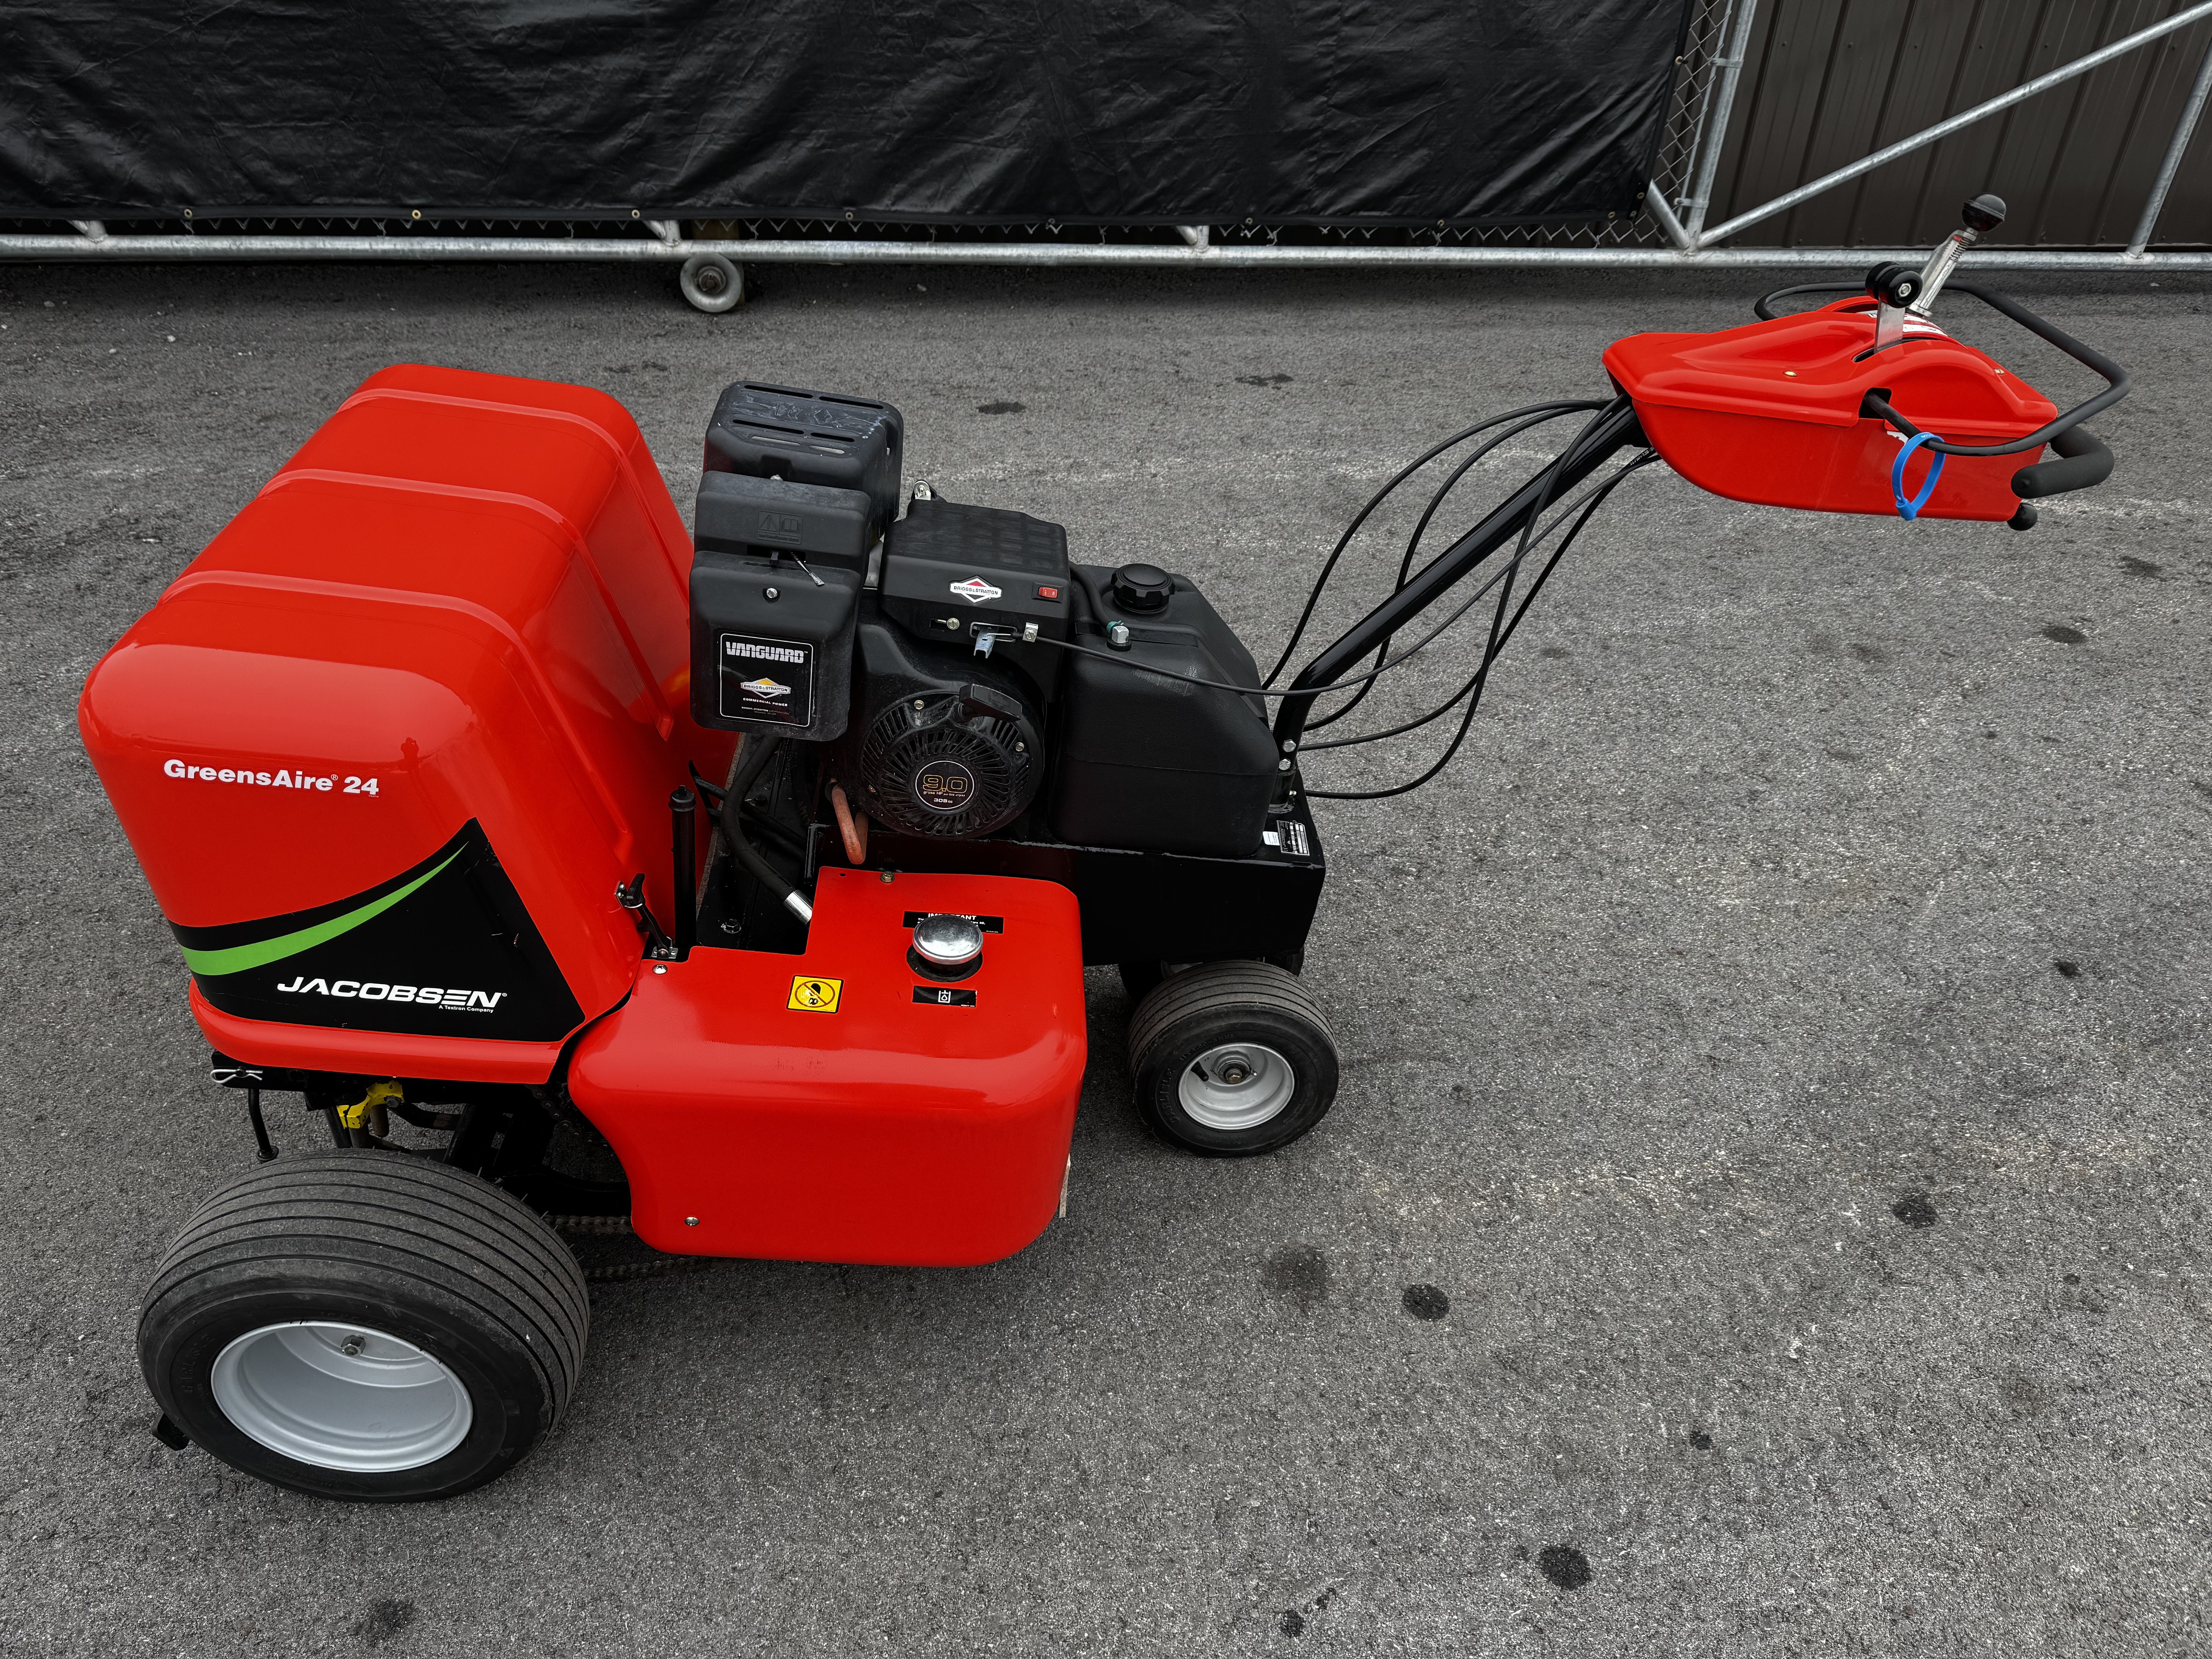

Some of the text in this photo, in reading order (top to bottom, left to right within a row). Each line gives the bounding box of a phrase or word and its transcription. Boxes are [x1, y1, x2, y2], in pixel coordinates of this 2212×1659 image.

[726, 641, 804, 663] VANGUARD
[343, 776, 379, 795] 24
[922, 775, 968, 793] 9.0
[277, 976, 502, 1008] JACOBSEN
